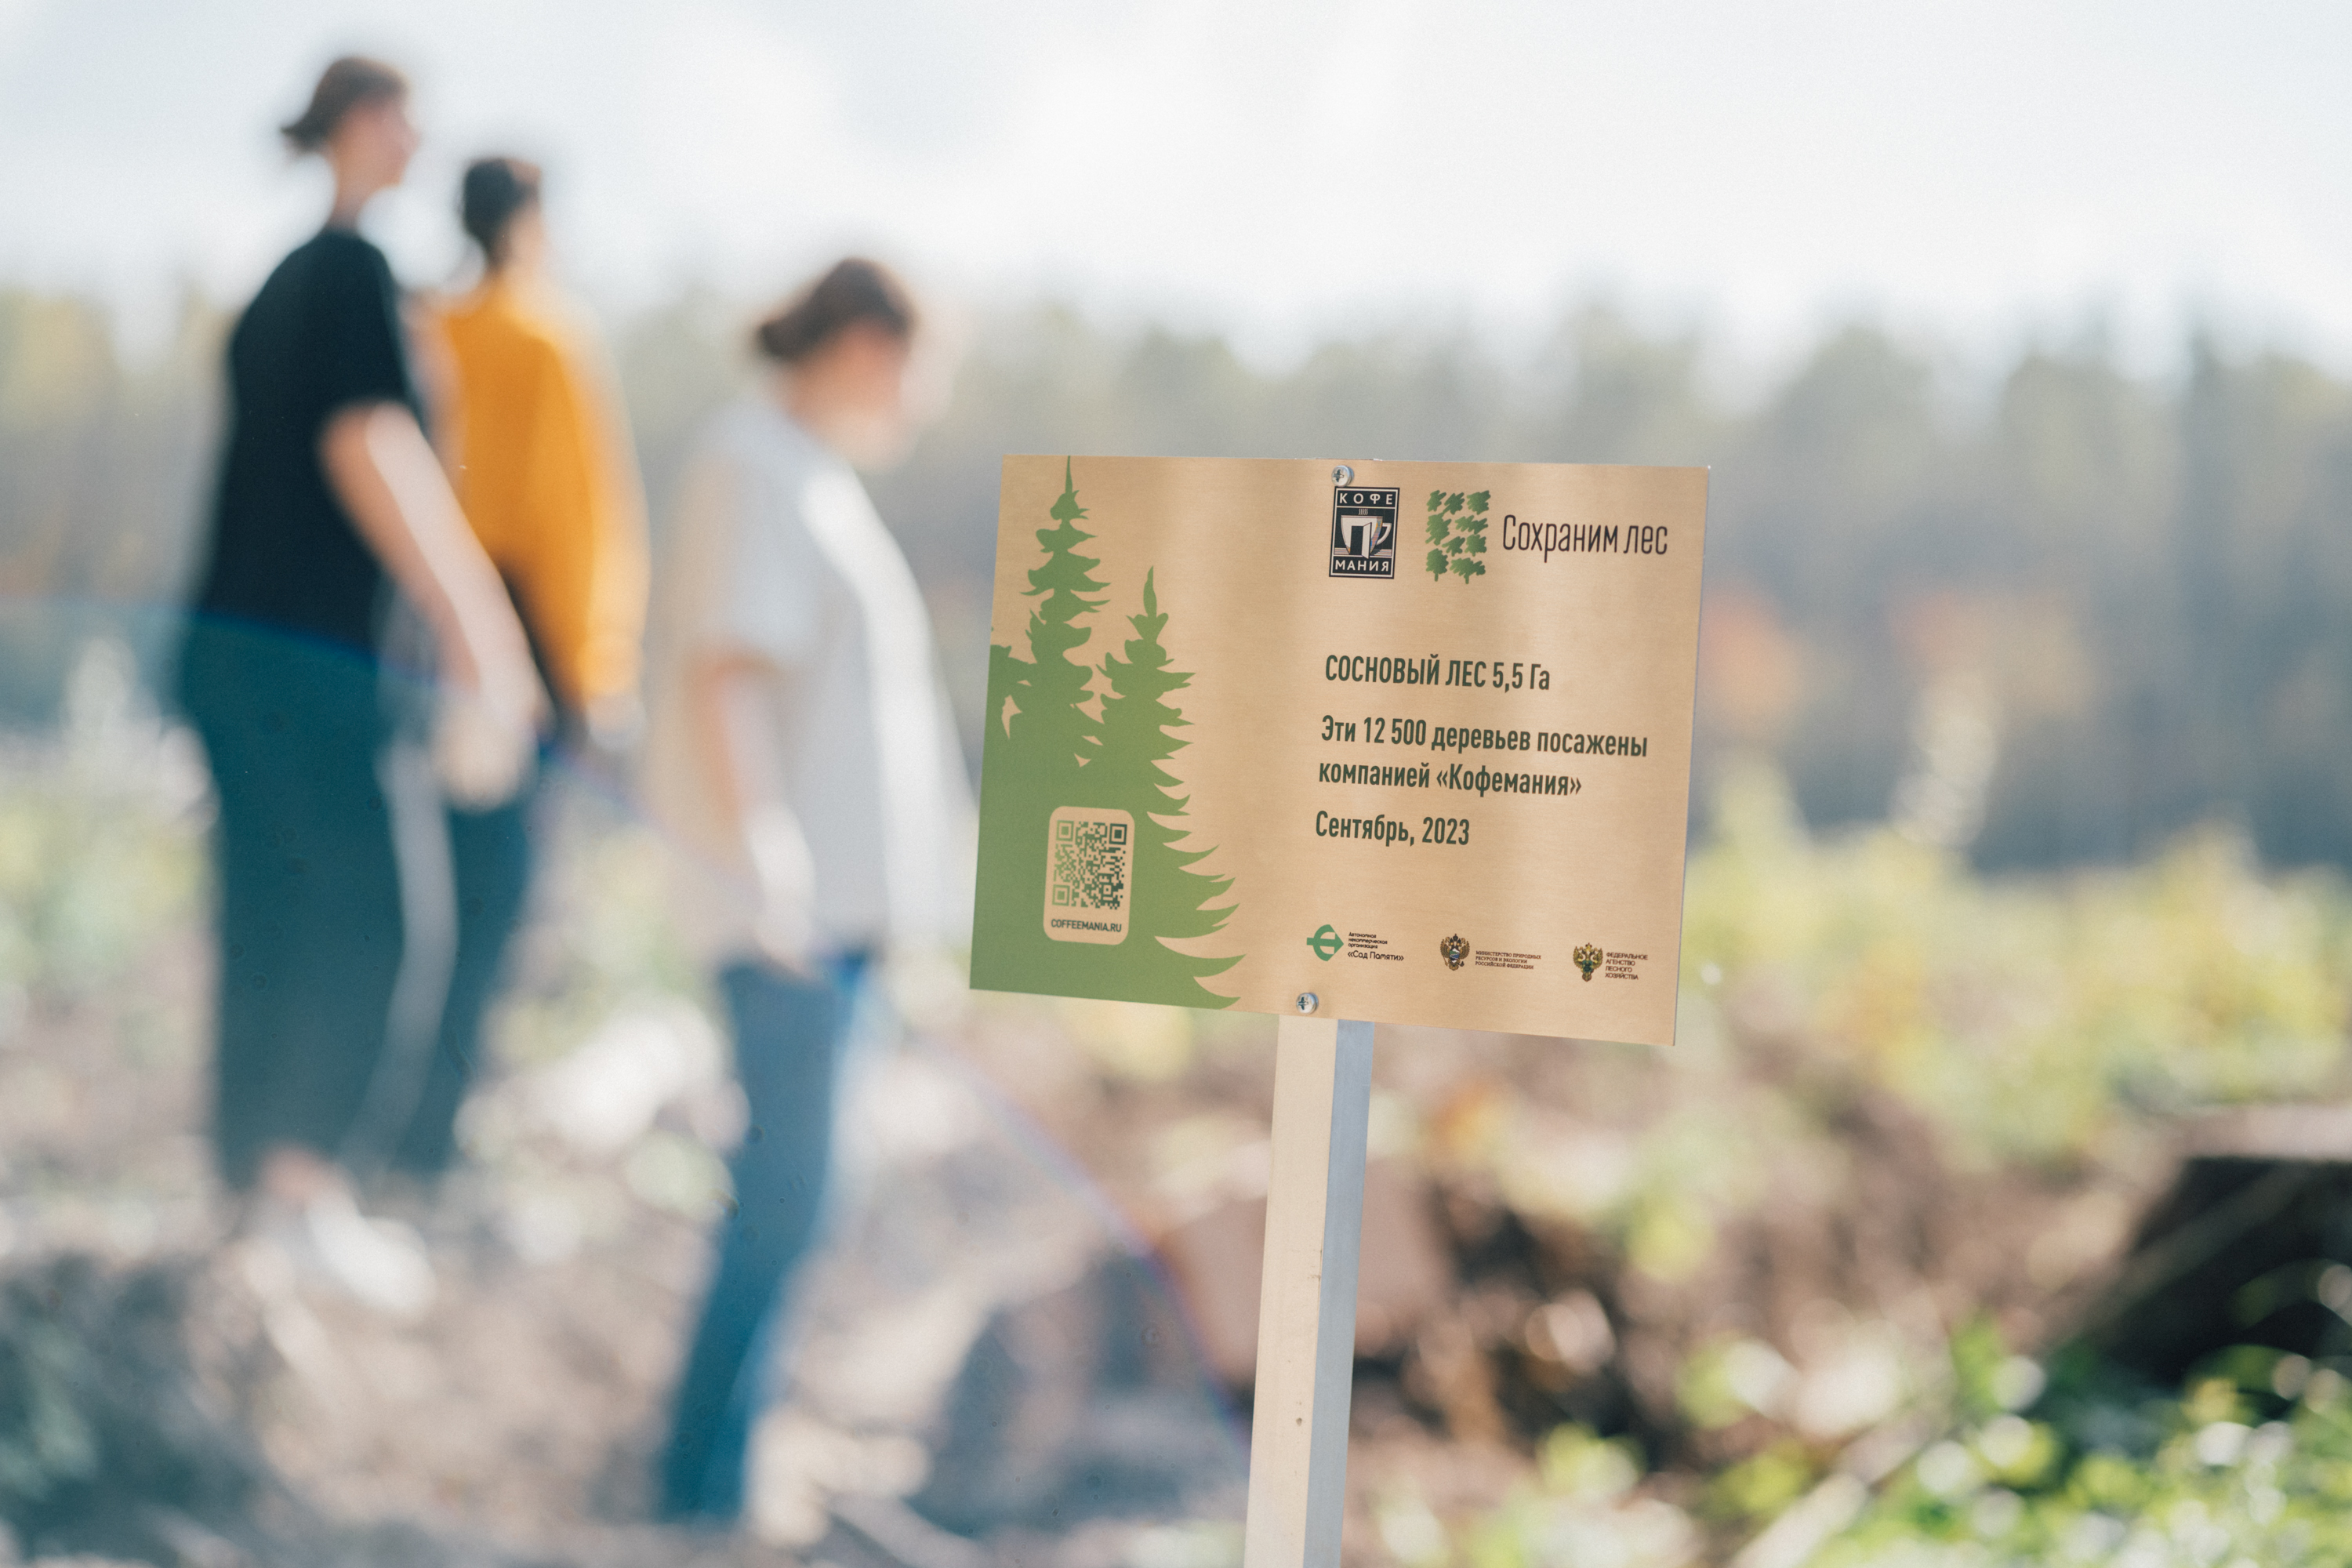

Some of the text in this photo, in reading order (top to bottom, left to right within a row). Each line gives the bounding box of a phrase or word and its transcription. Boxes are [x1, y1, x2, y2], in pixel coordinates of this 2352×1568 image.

[1339, 492, 1393, 505] КОФЕ
[1502, 514, 1668, 564] Сохраним лес
[1335, 559, 1389, 572] МАНИЯ
[1325, 653, 1550, 693] СОСНОВЫЙ ЛЕС 5,5 Га
[1321, 714, 1648, 757] Эти 12 500 деревьев посажены
[1319, 761, 1582, 798] компанией «Кофемания»
[1316, 810, 1470, 848] Сентябрь, 2023
[1051, 919, 1122, 932] COFFEEMANIA.RU
[1606, 952, 1648, 960] ФЕДЕРАЛЬНОЕ
